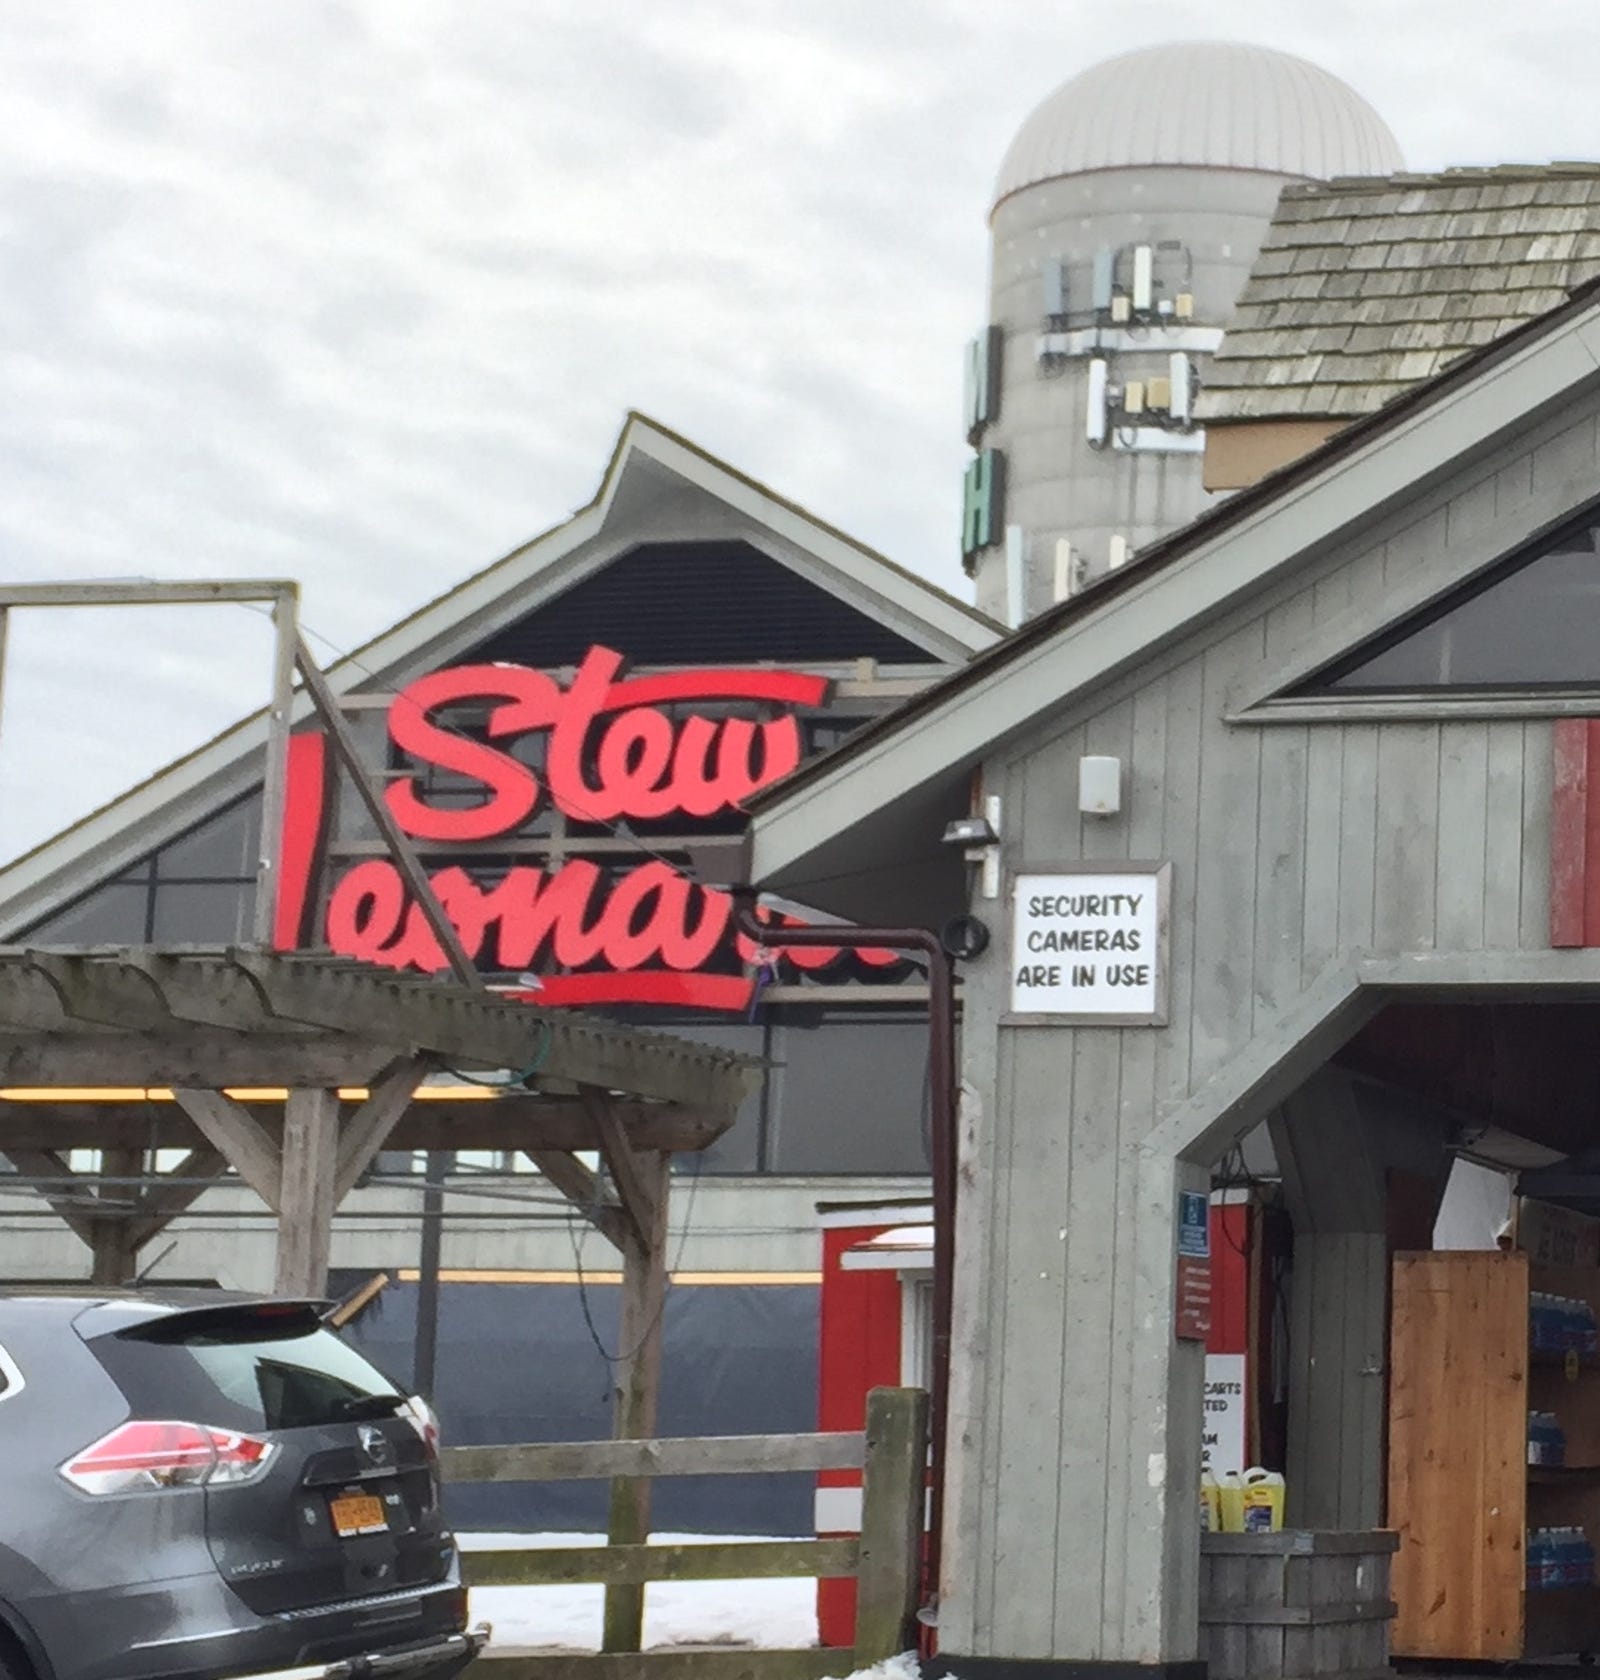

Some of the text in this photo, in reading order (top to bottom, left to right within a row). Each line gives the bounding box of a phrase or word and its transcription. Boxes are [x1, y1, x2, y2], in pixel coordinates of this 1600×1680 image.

[384, 645, 827, 840] Stew
[1028, 894, 1142, 917] SECURITY
[1027, 929, 1141, 952] CAMERAS
[1016, 965, 1149, 987] ARE IN USE
